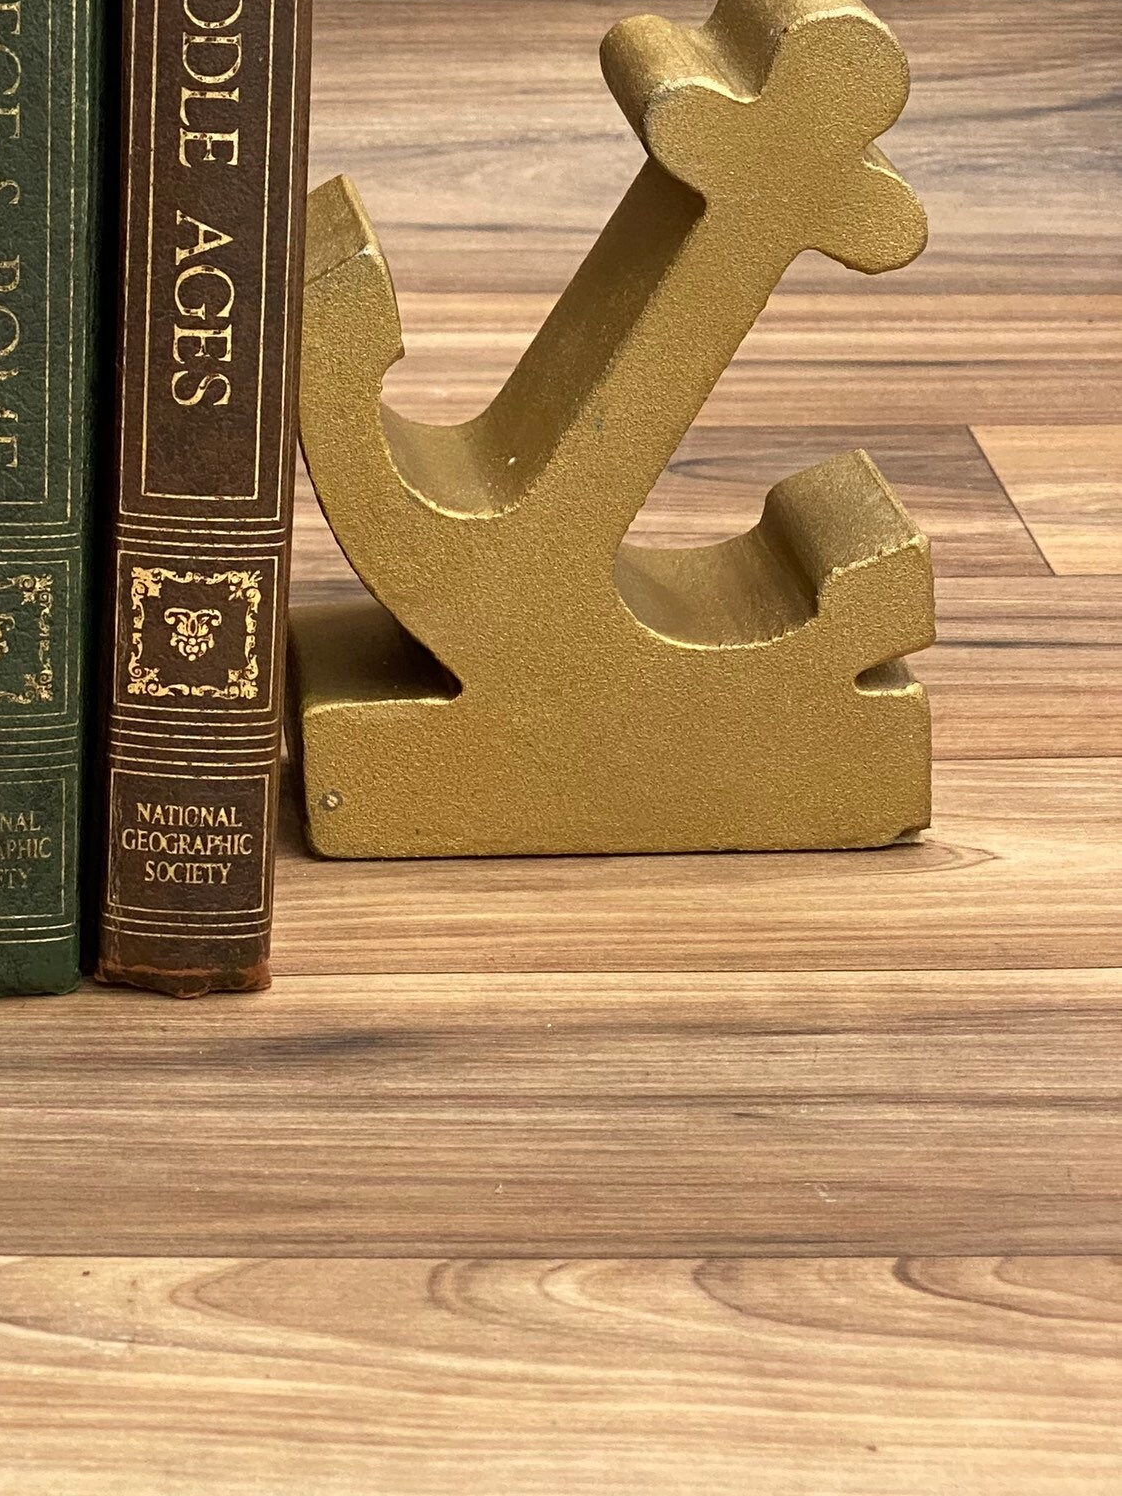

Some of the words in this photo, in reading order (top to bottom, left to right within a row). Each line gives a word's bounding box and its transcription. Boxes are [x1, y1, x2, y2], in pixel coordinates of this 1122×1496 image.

[171, 209, 235, 409] AGES
[136, 803, 243, 828] NATIONAL
[122, 830, 254, 857] GEOGRAPHIC
[144, 860, 232, 885] SOCIETY
